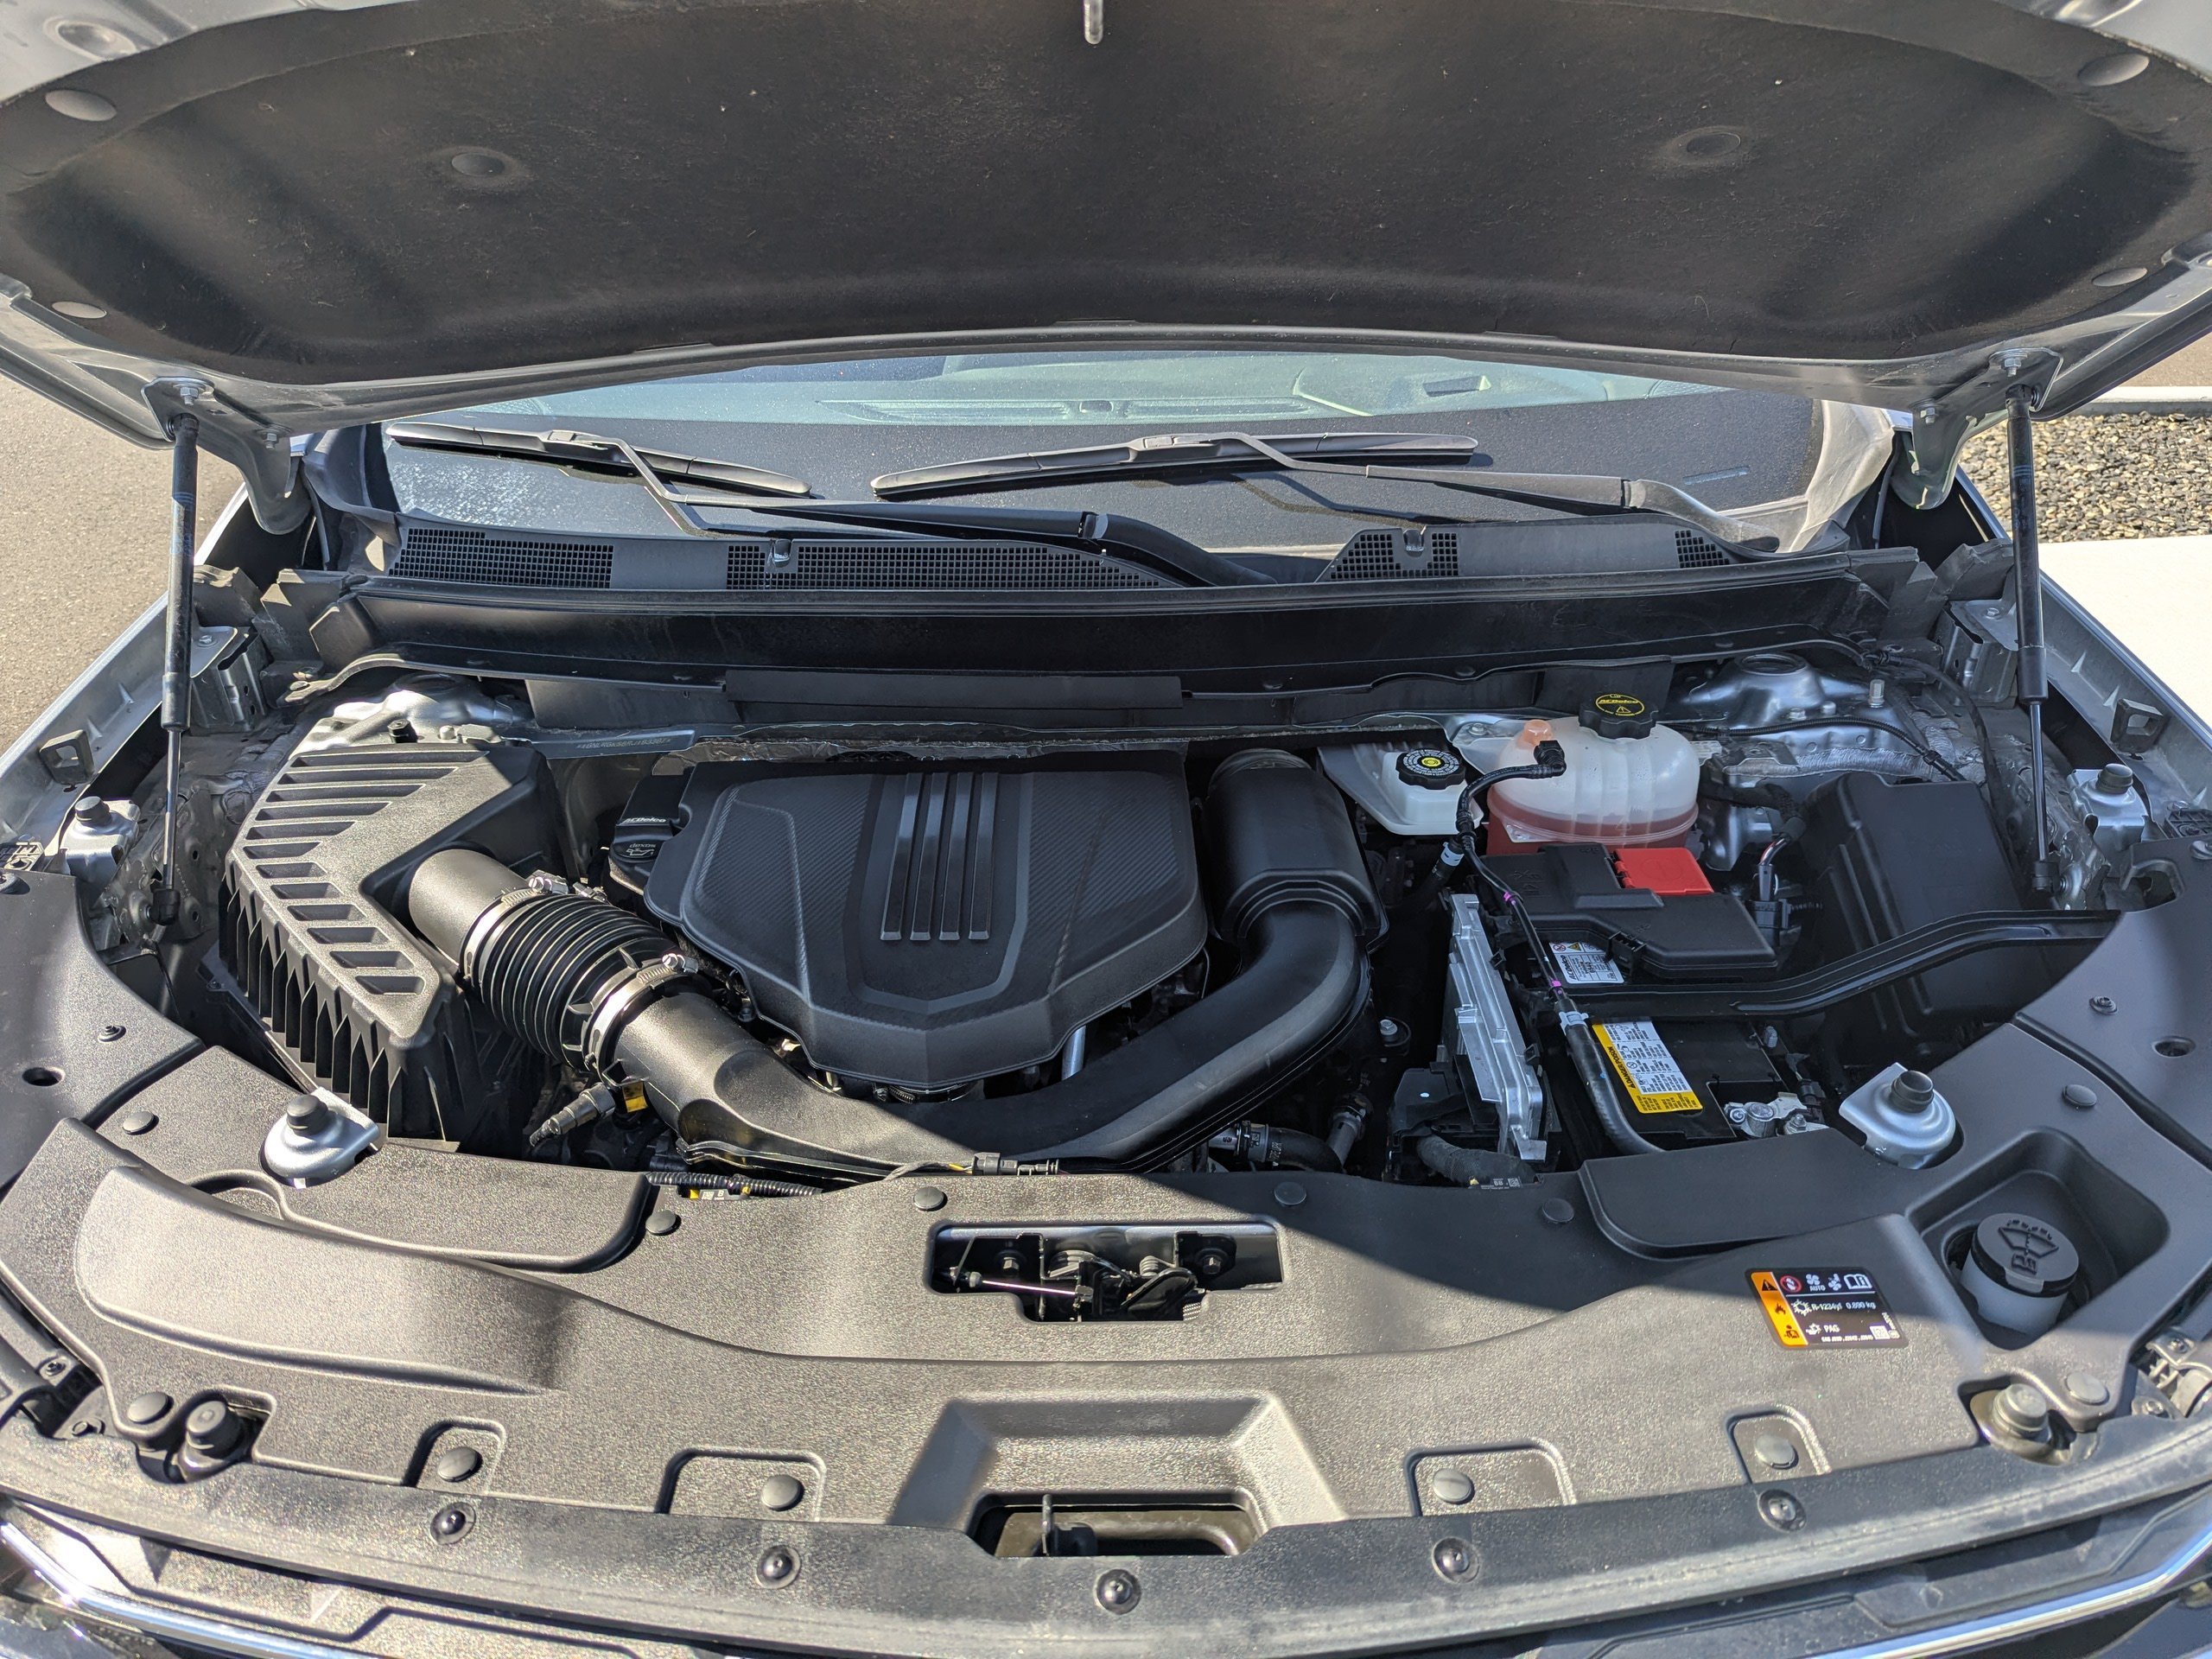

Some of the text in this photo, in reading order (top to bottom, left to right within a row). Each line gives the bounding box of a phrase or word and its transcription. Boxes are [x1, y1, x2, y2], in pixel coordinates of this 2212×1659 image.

[1606, 1046, 1632, 1083] DANGER POISON
[1866, 1301, 1877, 1310] kg
[1823, 1325, 1840, 1333] PAG
